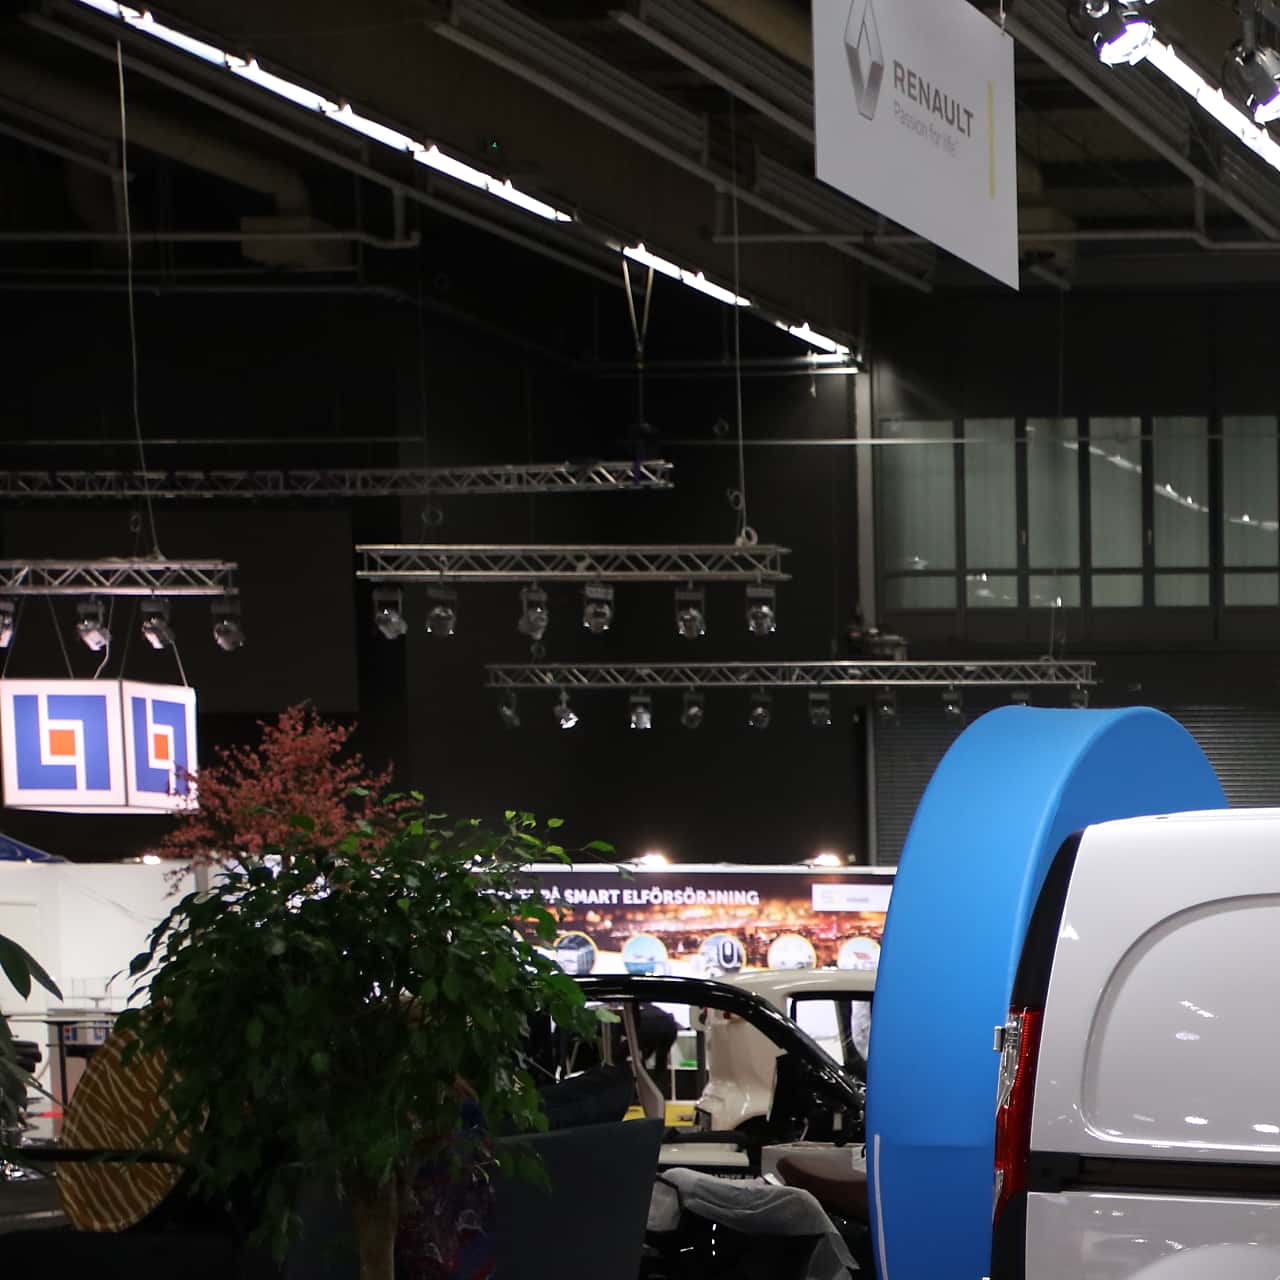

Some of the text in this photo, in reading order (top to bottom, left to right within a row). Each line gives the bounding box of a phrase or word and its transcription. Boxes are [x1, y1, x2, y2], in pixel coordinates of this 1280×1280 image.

[893, 59, 974, 137] RENAULT
[564, 888, 620, 905] SMART
[622, 886, 759, 905] ELFÖRSÖRJNING
